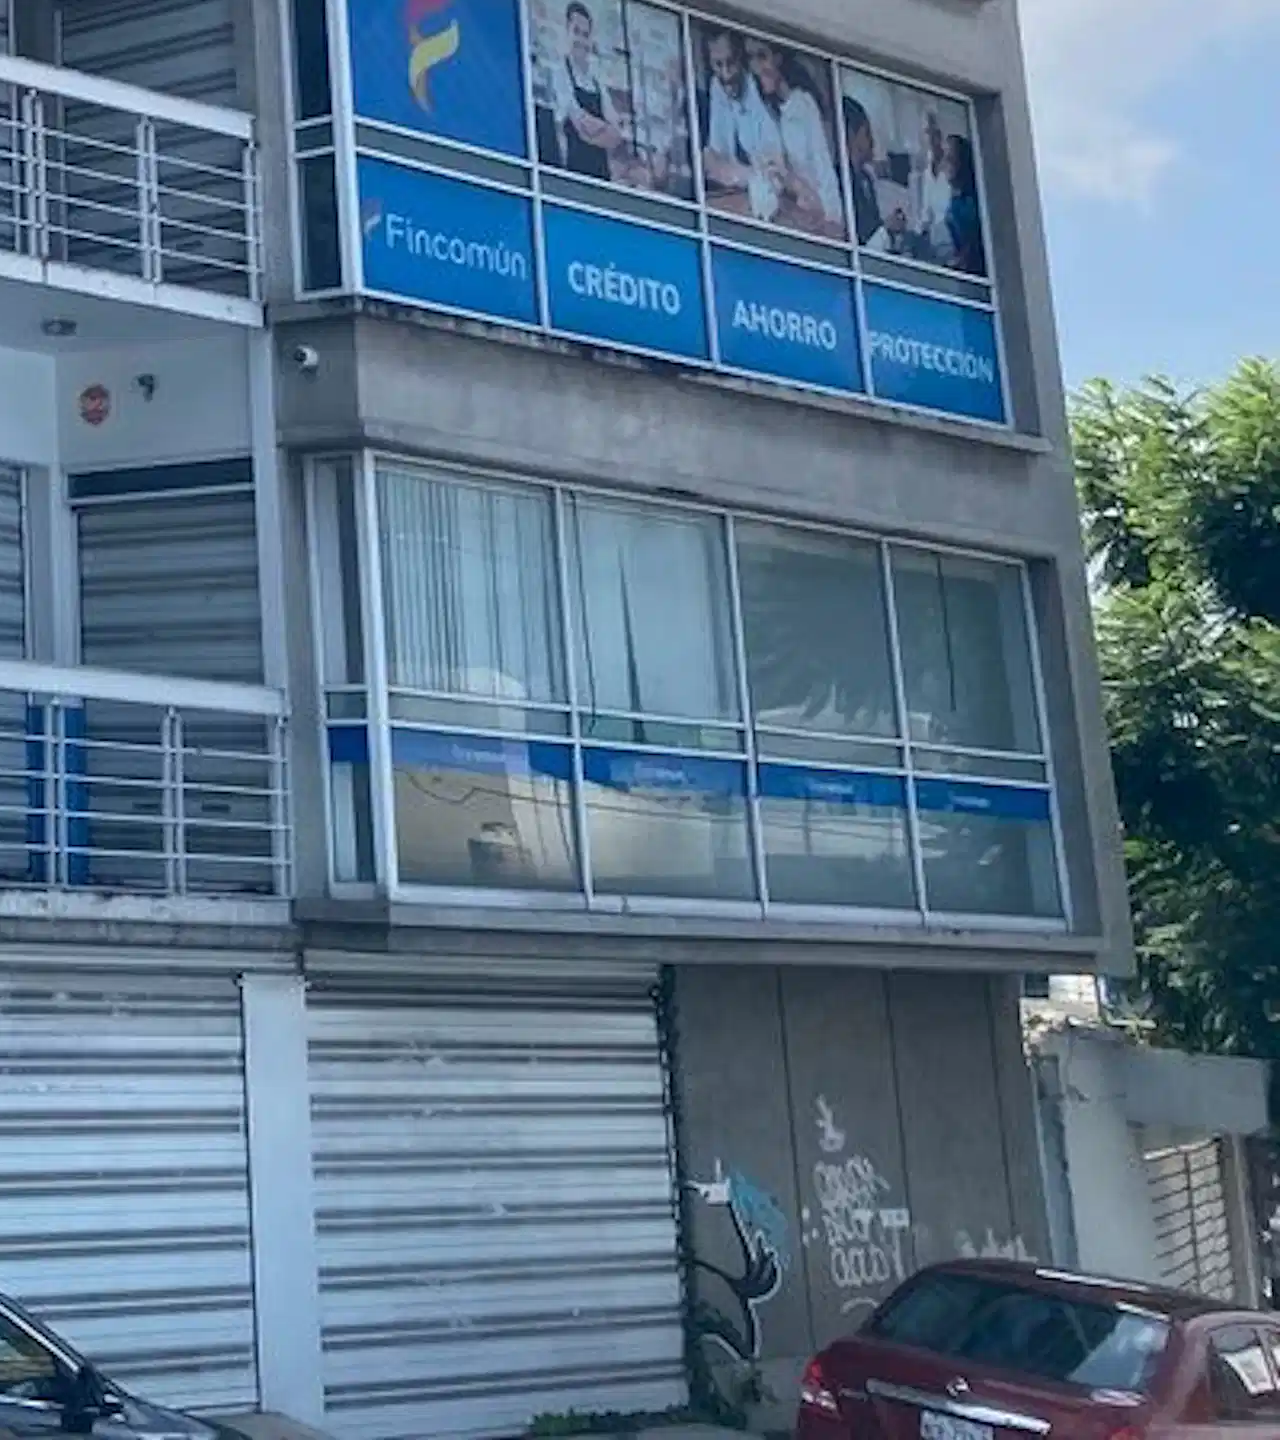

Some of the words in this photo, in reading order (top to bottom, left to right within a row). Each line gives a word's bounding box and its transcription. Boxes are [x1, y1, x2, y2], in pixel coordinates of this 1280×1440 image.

[385, 212, 528, 281] Fincomún
[567, 261, 682, 316] CRÉDITO
[731, 298, 838, 351] AHORRO
[867, 329, 995, 384] PROTECCIÓN
